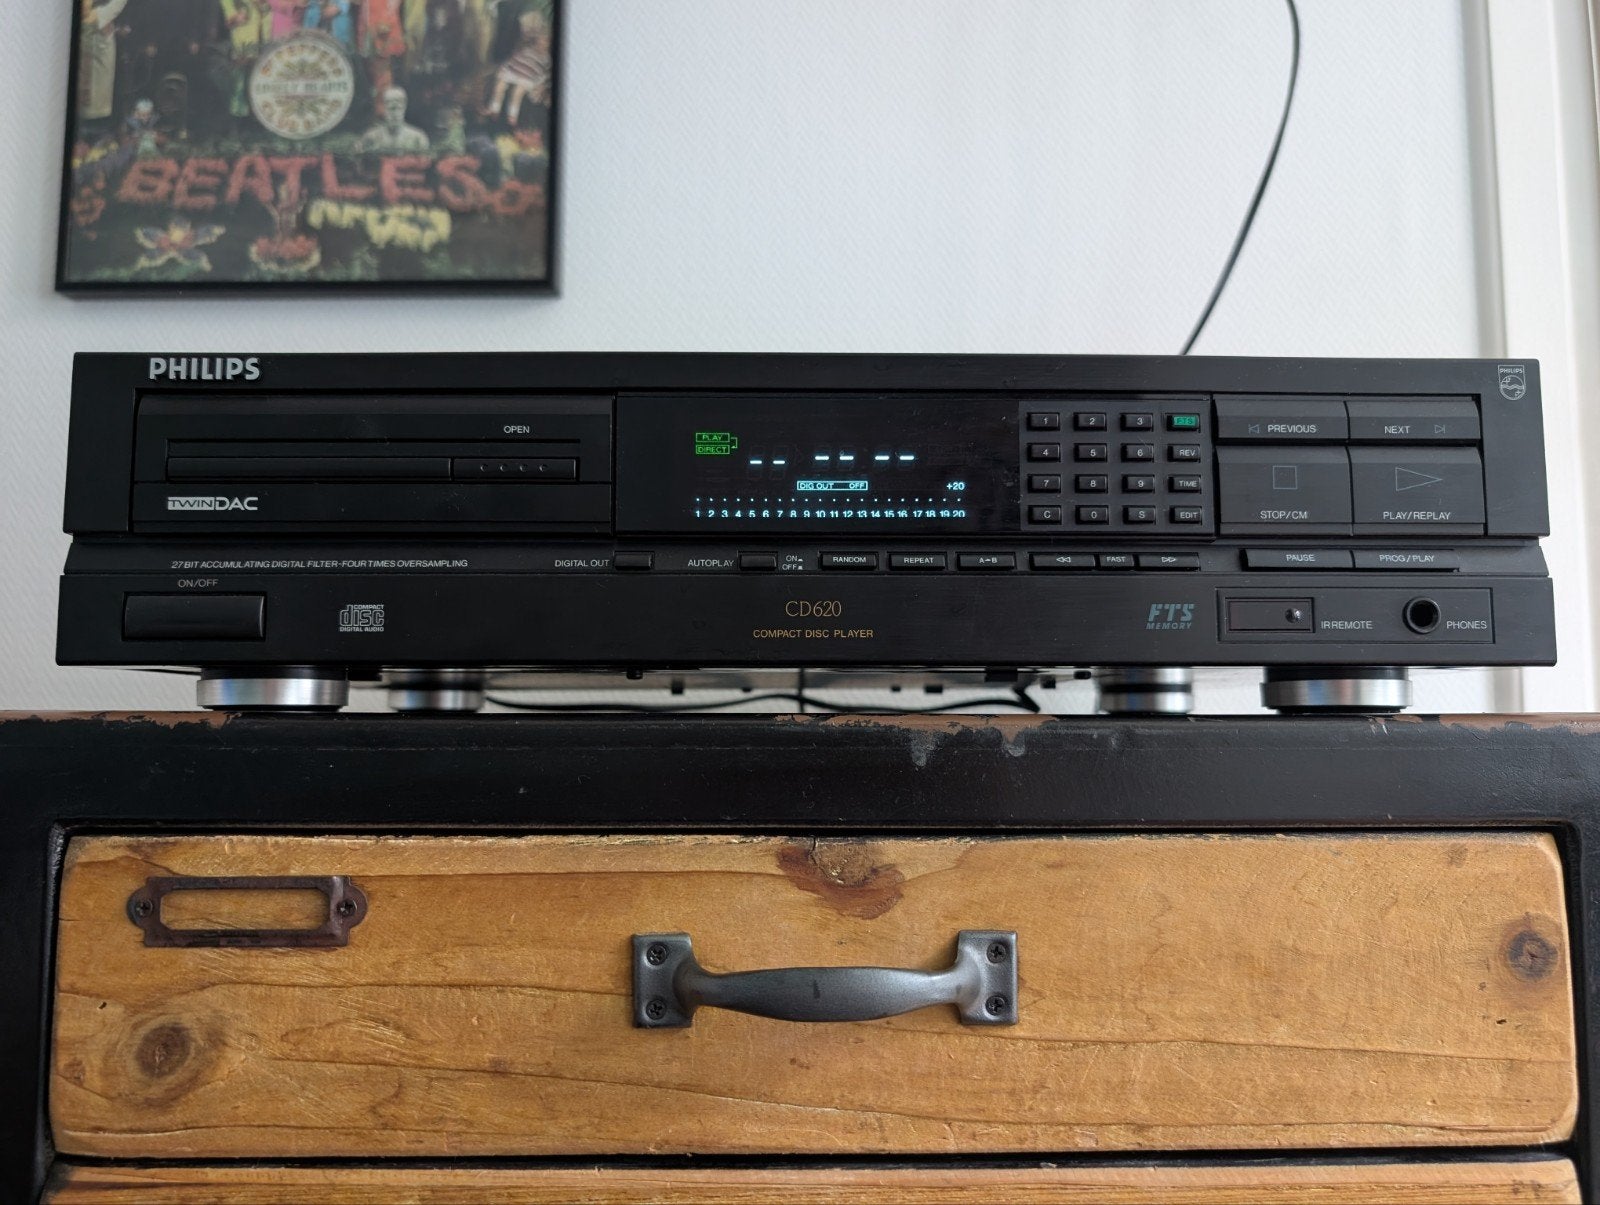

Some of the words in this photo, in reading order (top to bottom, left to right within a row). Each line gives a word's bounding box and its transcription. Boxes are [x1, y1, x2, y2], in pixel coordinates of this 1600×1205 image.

[114, 153, 489, 212] BEATLES
[149, 357, 260, 381] PHILIPS
[1043, 417, 1049, 425] 1
[1089, 417, 1096, 425] 2
[1136, 417, 1144, 425] 3
[503, 425, 530, 434] OPEN
[1267, 424, 1317, 434] PREVIOUS
[1384, 425, 1410, 434] NEXT
[1042, 449, 1049, 457] 4
[1090, 449, 1097, 457] 5
[1137, 449, 1144, 457] 6
[1179, 449, 1196, 457] REV
[799, 481, 814, 490] DIG
[816, 481, 834, 490] OUT
[848, 481, 866, 490] OFF
[946, 481, 966, 491] +20
[1043, 480, 1049, 488] 7
[1090, 480, 1097, 488] 8
[1138, 480, 1145, 488] 9
[1179, 480, 1198, 488] TIME
[708, 509, 715, 518] 2
[721, 509, 729, 518] 3
[735, 509, 742, 518] 4
[749, 509, 756, 518] 5
[762, 509, 770, 518] 6
[777, 509, 784, 518] 7
[790, 509, 797, 518] 8
[803, 509, 811, 518] 9
[815, 509, 826, 518] 10
[829, 509, 839, 518] 11
[842, 509, 854, 518] 12
[856, 509, 868, 518] 13
[870, 509, 881, 518] 14
[884, 509, 895, 518] 15
[897, 509, 909, 518] 16
[913, 509, 924, 518] 17
[925, 509, 937, 518] 18
[939, 509, 951, 518] 19
[952, 509, 966, 518] 20
[1043, 511, 1051, 519] C
[1138, 511, 1145, 519] S
[1260, 511, 1308, 520] STOP/CM
[1383, 511, 1451, 520] PLAY/REPLAY
[1286, 554, 1315, 562] PAUSE
[200, 561, 270, 569] ACCUMULATING
[271, 561, 305, 569] DIGITAL
[369, 560, 396, 568] TIMES
[397, 559, 469, 568] OVERSAMPLING
[554, 559, 588, 568] DIGITAL
[590, 559, 609, 567] OUT
[688, 559, 734, 568] AUTOPLAY
[177, 579, 219, 588] ON/OFF
[785, 601, 842, 617] CD620
[1148, 603, 1195, 622] FTS
[1145, 622, 1192, 630] MEMORY
[1446, 620, 1487, 629] PHONES
[753, 630, 801, 638] COMPACT
[805, 630, 829, 638] DISC
[833, 630, 874, 638] PLAYER
